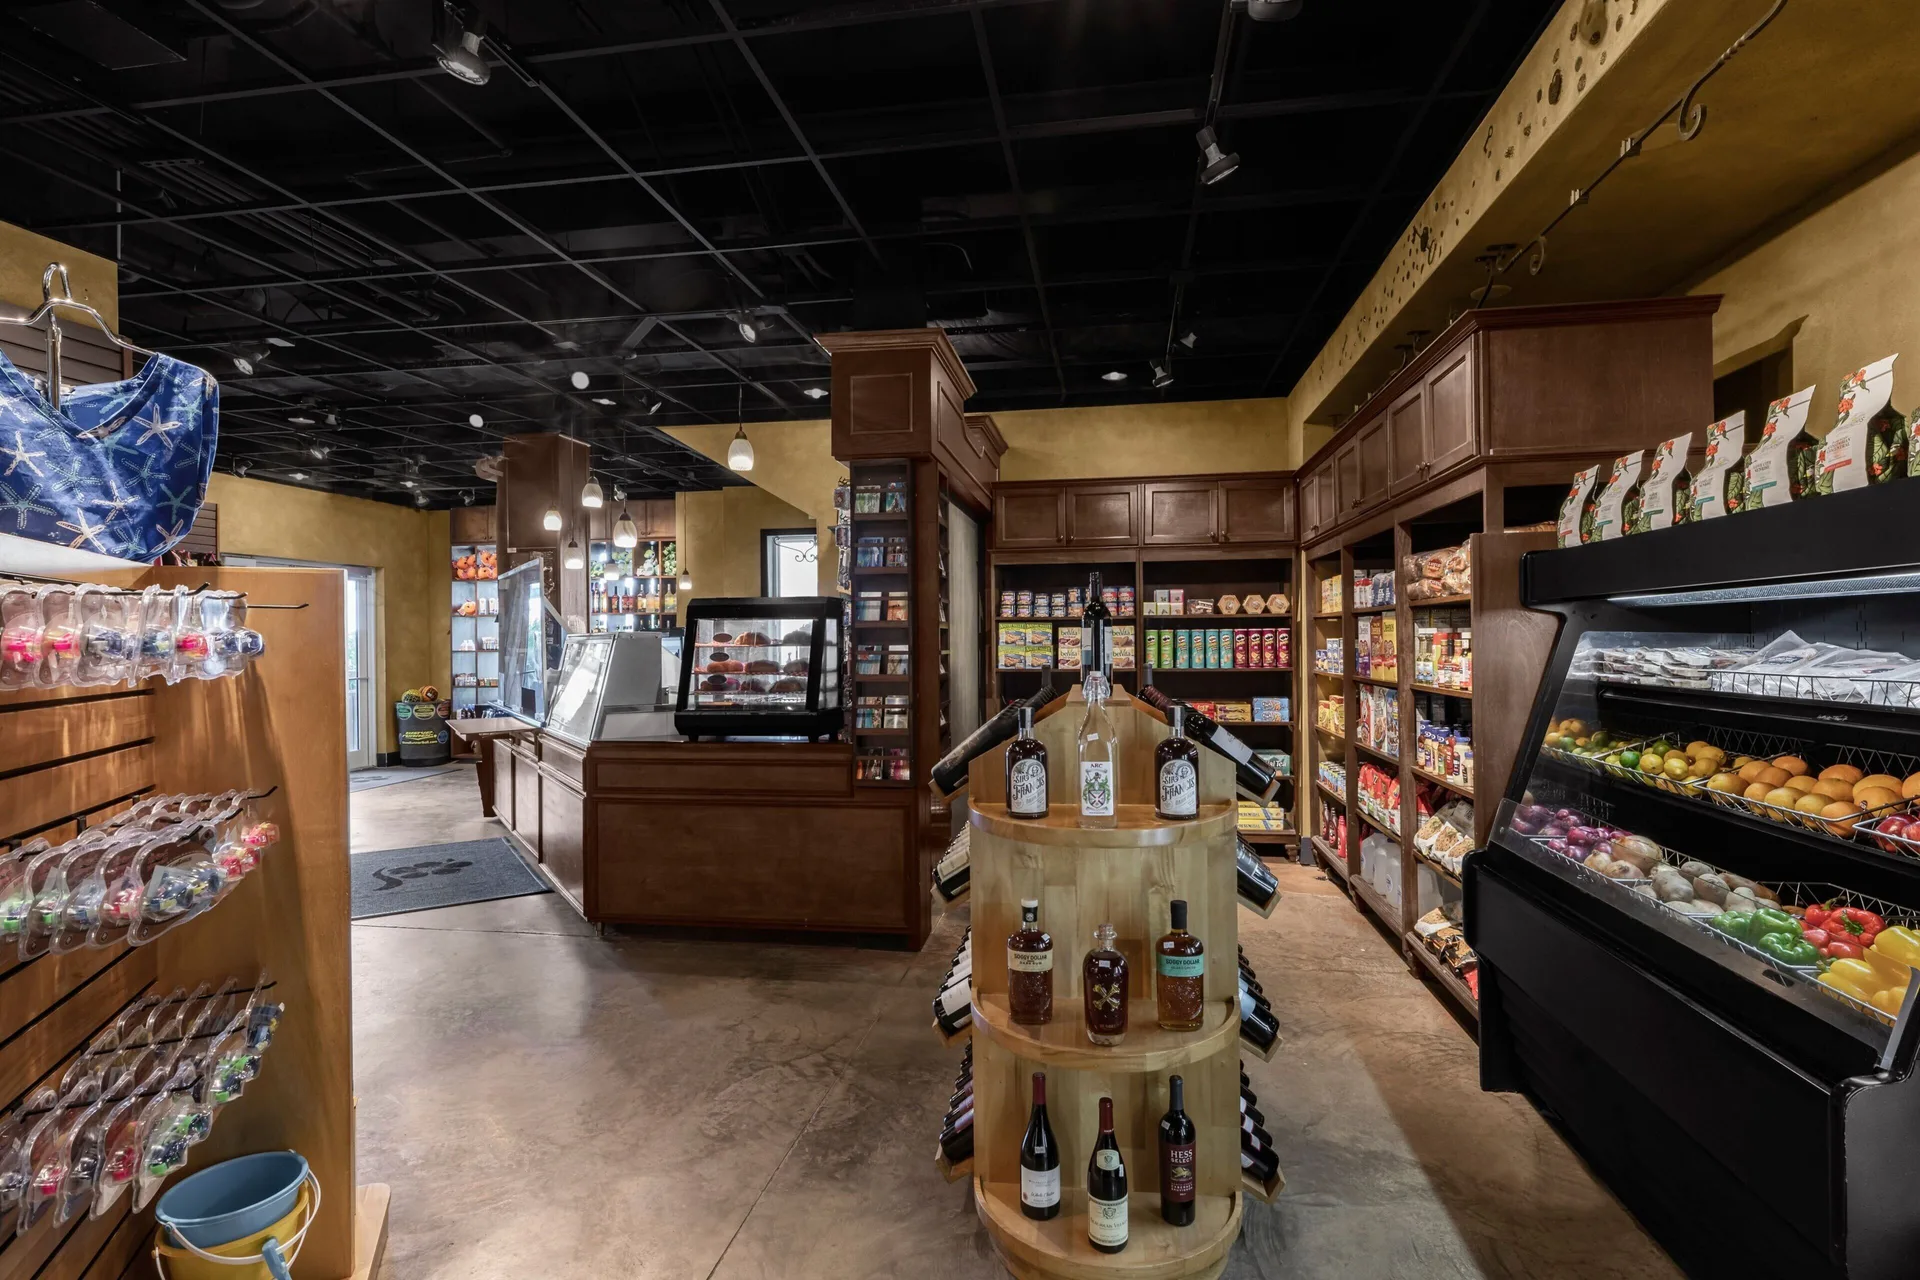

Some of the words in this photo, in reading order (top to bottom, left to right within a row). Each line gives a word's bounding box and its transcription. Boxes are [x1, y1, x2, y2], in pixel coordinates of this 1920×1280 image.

[1013, 774, 1030, 784] SIR
[1163, 775, 1179, 785] SIR
[1171, 1149, 1193, 1159] HESS
